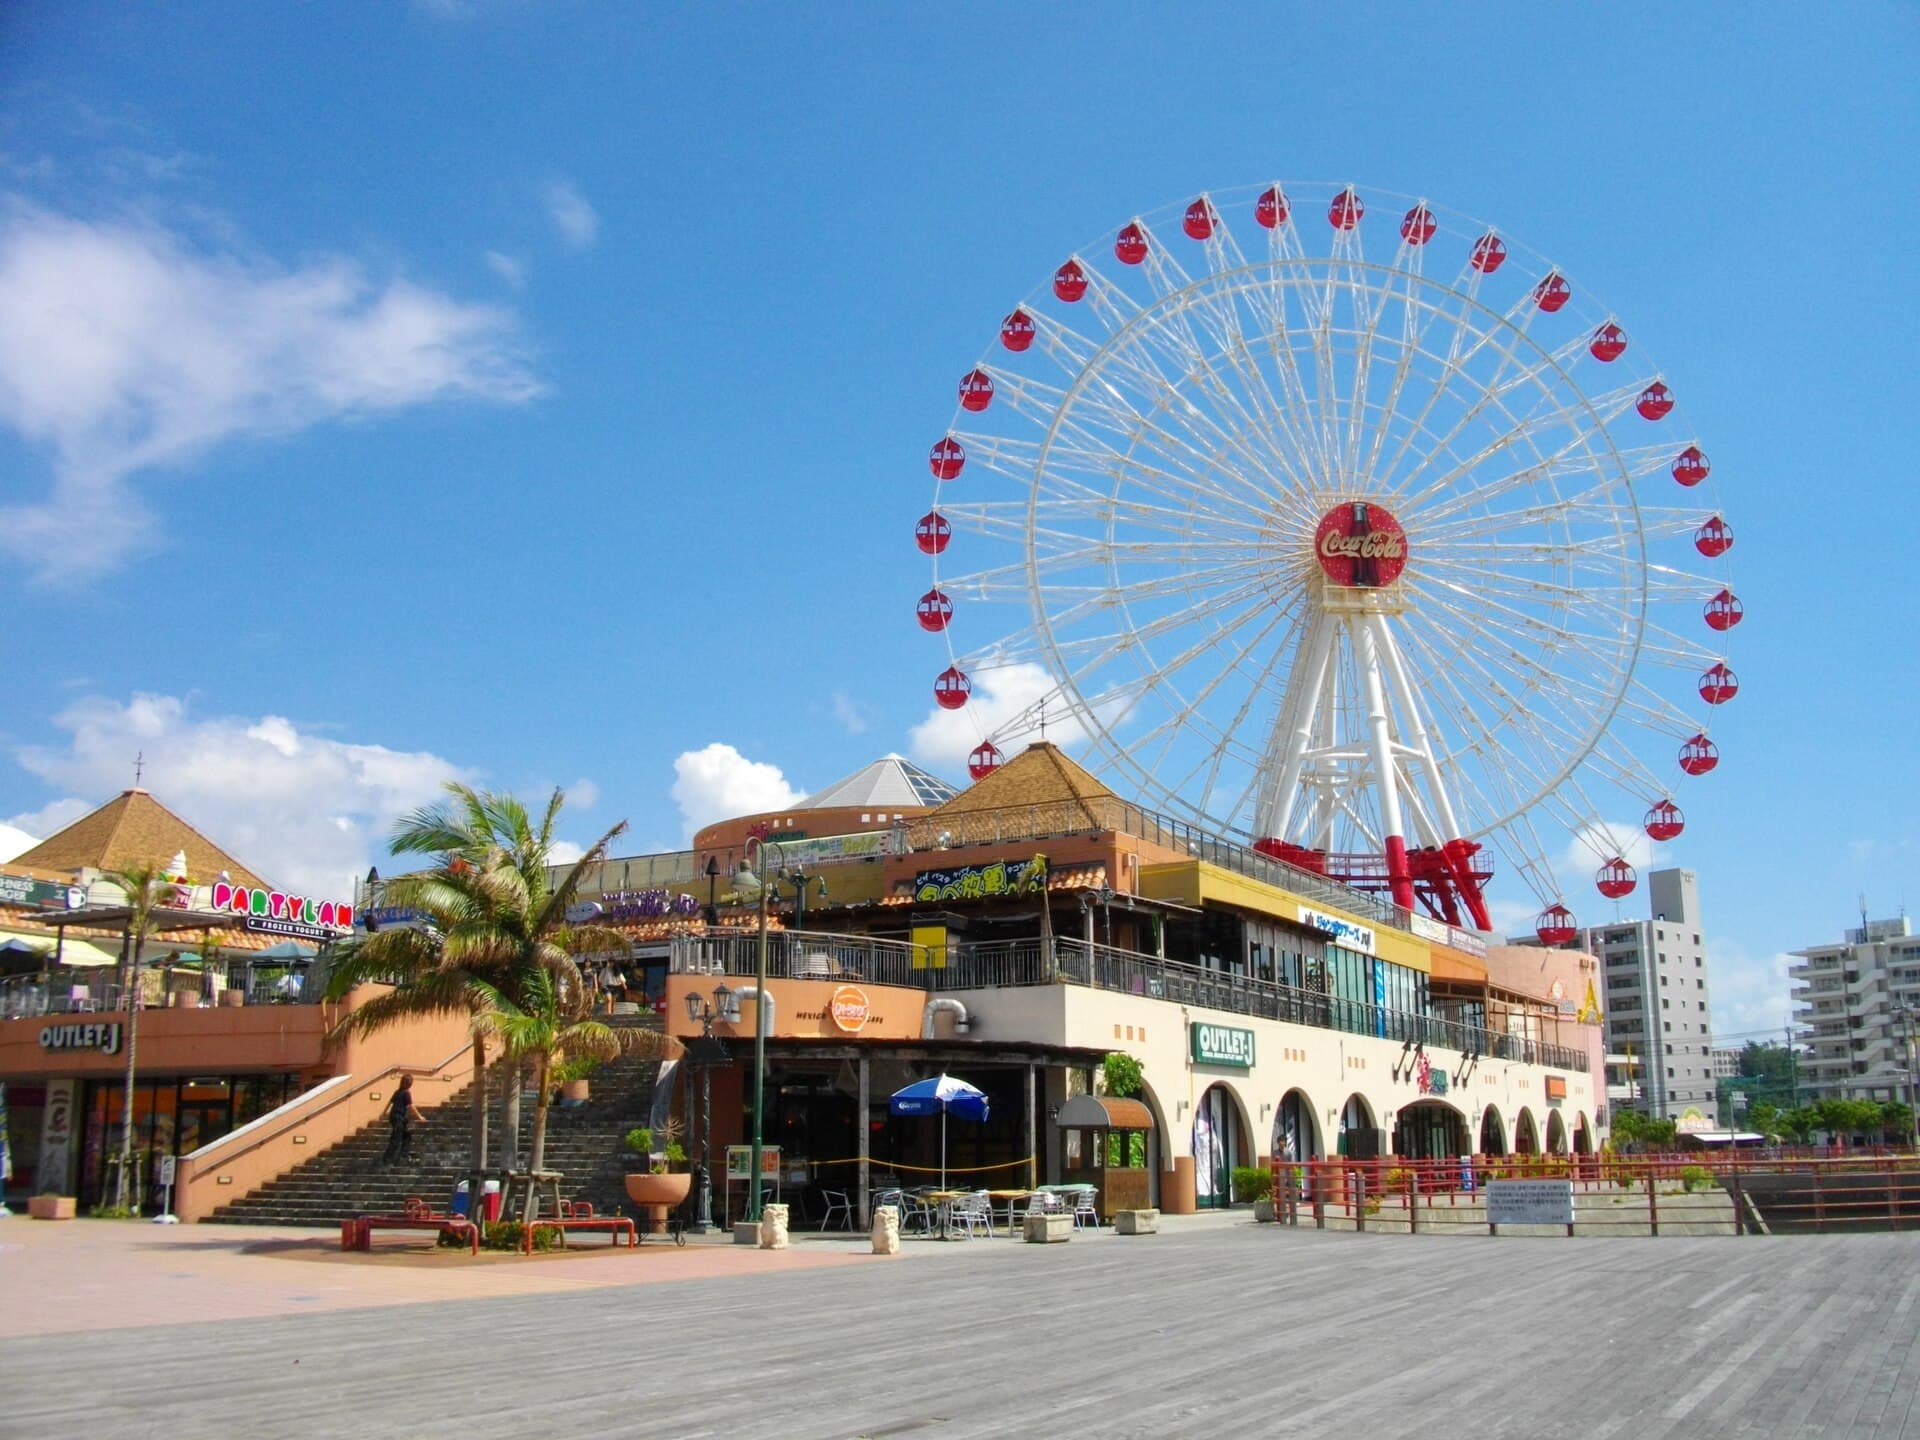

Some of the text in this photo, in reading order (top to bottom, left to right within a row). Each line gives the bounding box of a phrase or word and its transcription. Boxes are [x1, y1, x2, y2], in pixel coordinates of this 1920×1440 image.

[262, 922, 325, 936] FROZEN YOGURT
[796, 1011, 827, 1020] MEXICO
